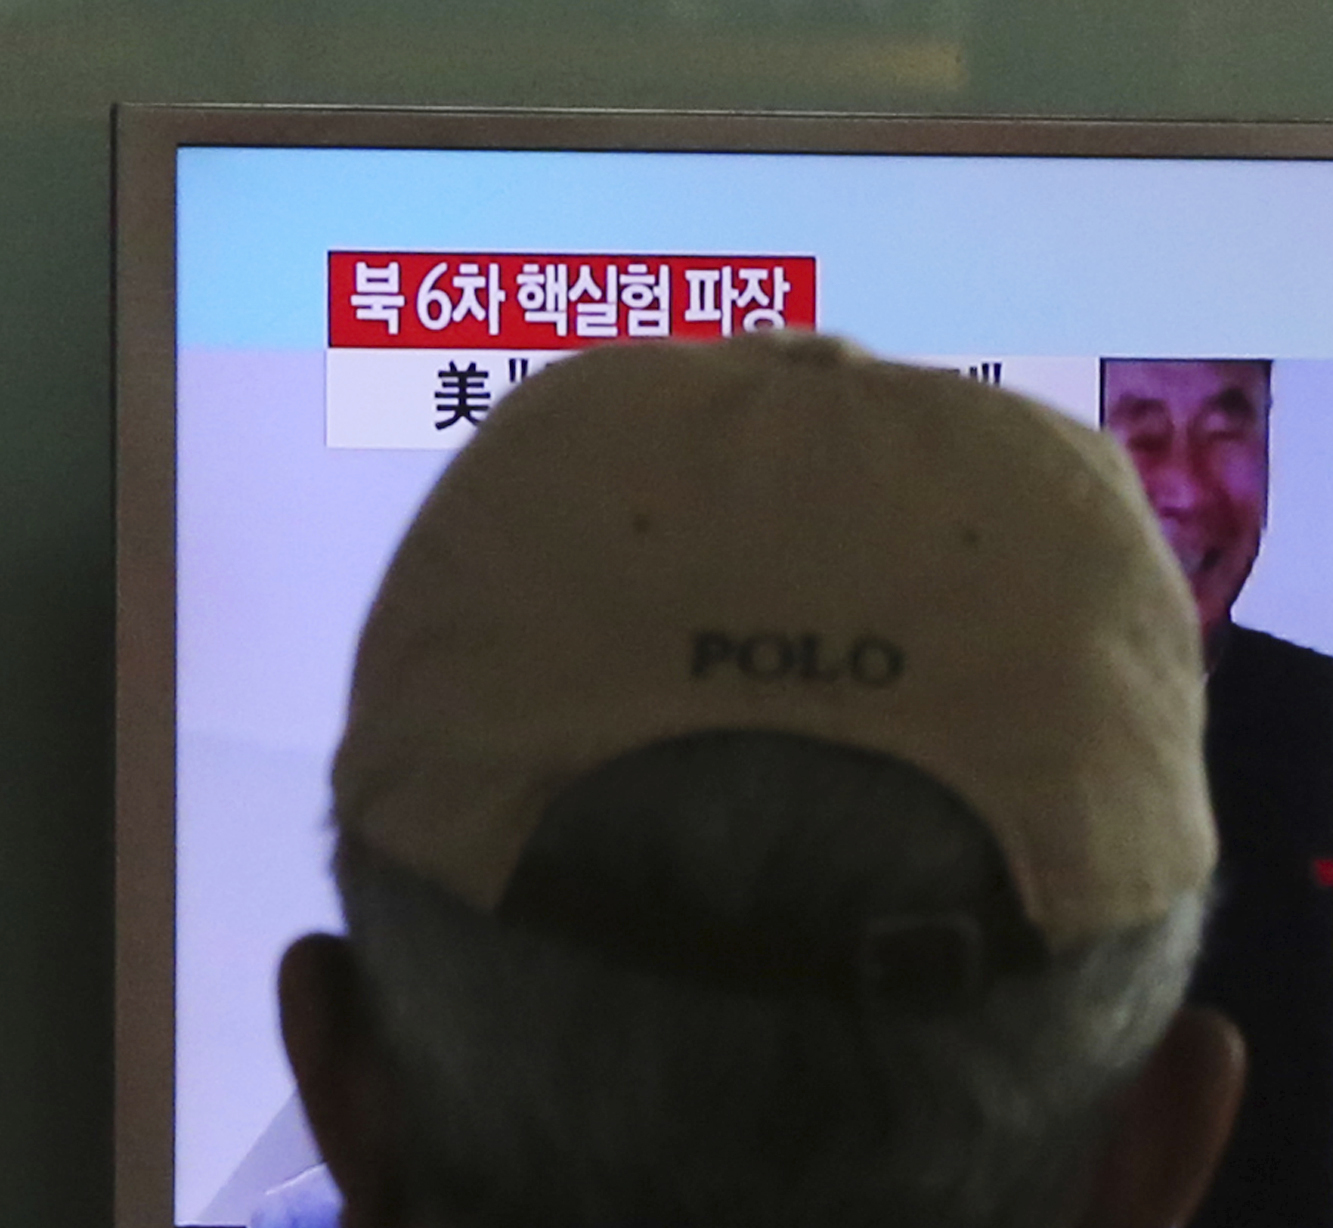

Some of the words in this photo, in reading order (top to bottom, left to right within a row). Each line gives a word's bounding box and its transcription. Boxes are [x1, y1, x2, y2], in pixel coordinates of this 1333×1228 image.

[351, 261, 405, 335] 북
[416, 262, 507, 337] 6차
[516, 263, 672, 338] 핵실험
[684, 265, 792, 338] 파장
[434, 360, 491, 431] 美
[691, 629, 906, 687] POLO
